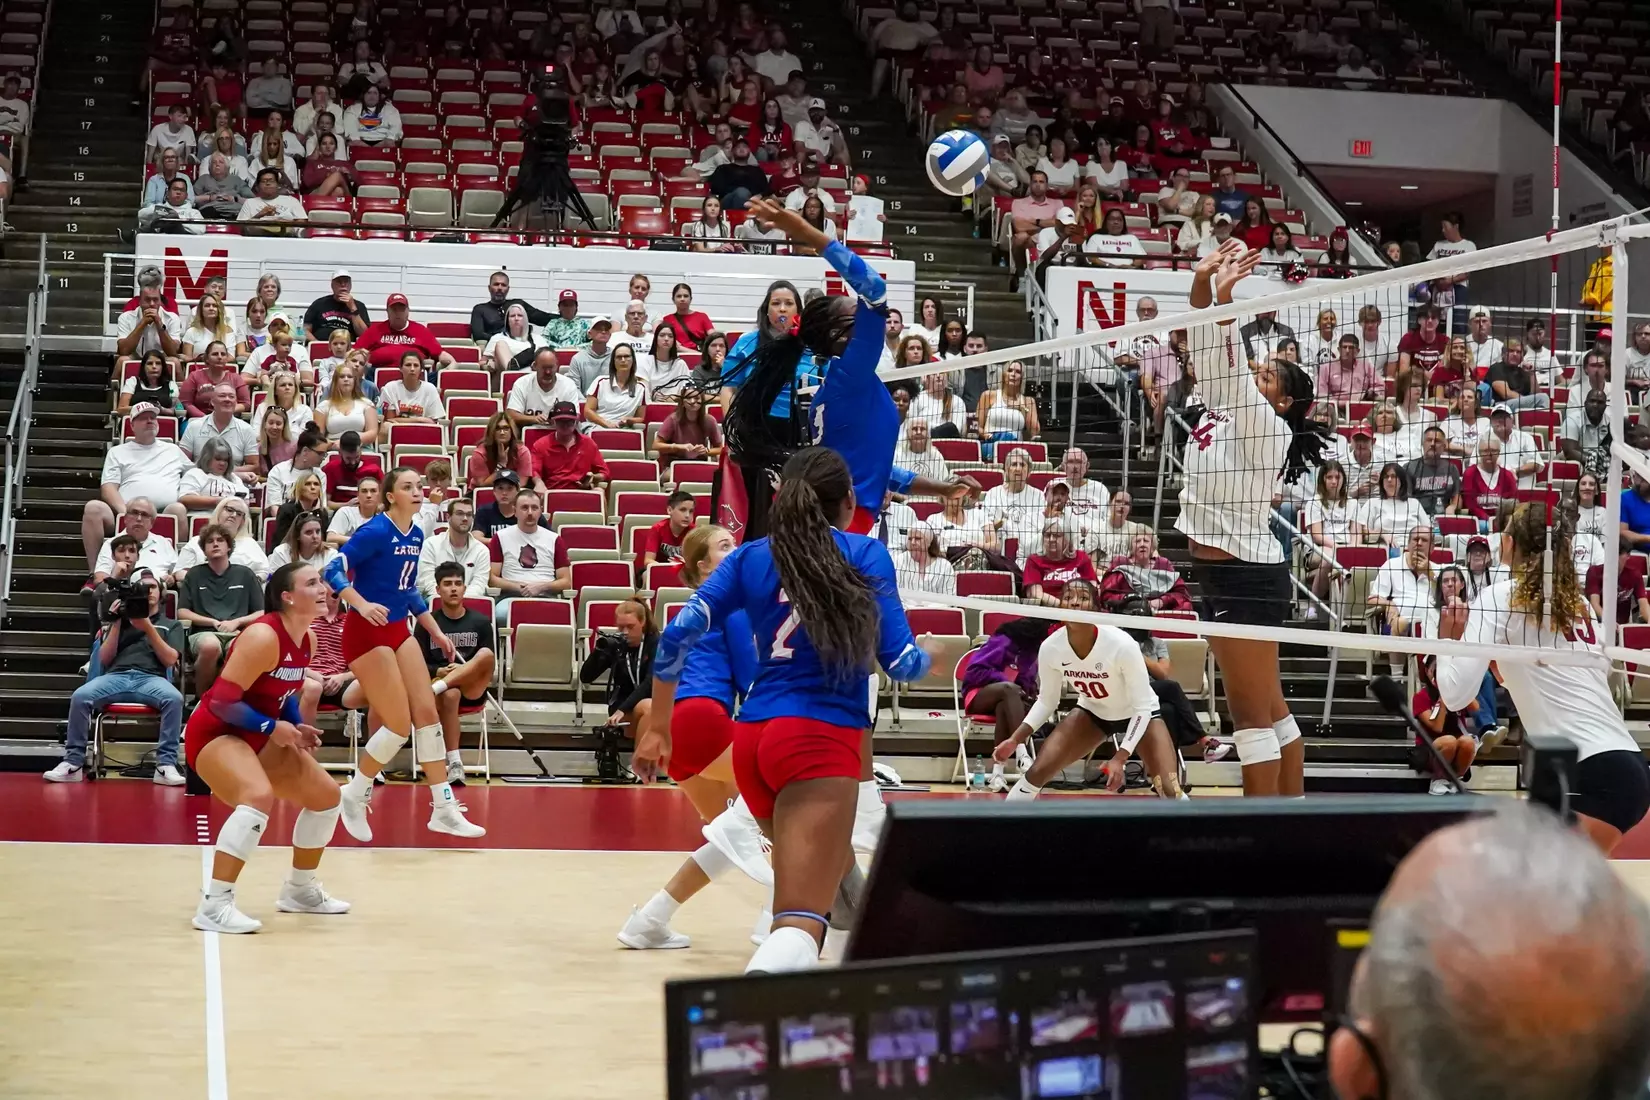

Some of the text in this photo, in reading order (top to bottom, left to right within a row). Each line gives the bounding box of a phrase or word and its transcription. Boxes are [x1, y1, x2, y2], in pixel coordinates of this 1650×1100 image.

[94, 76, 104, 84] 19
[84, 98, 95, 107] 18
[839, 105, 849, 113] 19
[81, 121, 92, 130] 17
[849, 127, 860, 135] 18
[78, 146, 89, 155] 16
[1354, 141, 1372, 156] EXIT
[862, 150, 872, 159] 17
[73, 172, 85, 181] 15
[876, 176, 887, 184] 16
[69, 196, 81, 206] 14
[890, 201, 902, 210] 15
[66, 223, 78, 232] 13
[905, 226, 917, 235] 14
[62, 250, 75, 260] 12
[923, 252, 935, 262] 13
[163, 247, 228, 309] M
[59, 278, 69, 288] 11
[956, 308, 967, 317] 11
[1077, 280, 1126, 346] N
[398, 560, 415, 590] 11
[1063, 670, 1109, 679] ARKANSAS
[1073, 681, 1109, 699] 30
